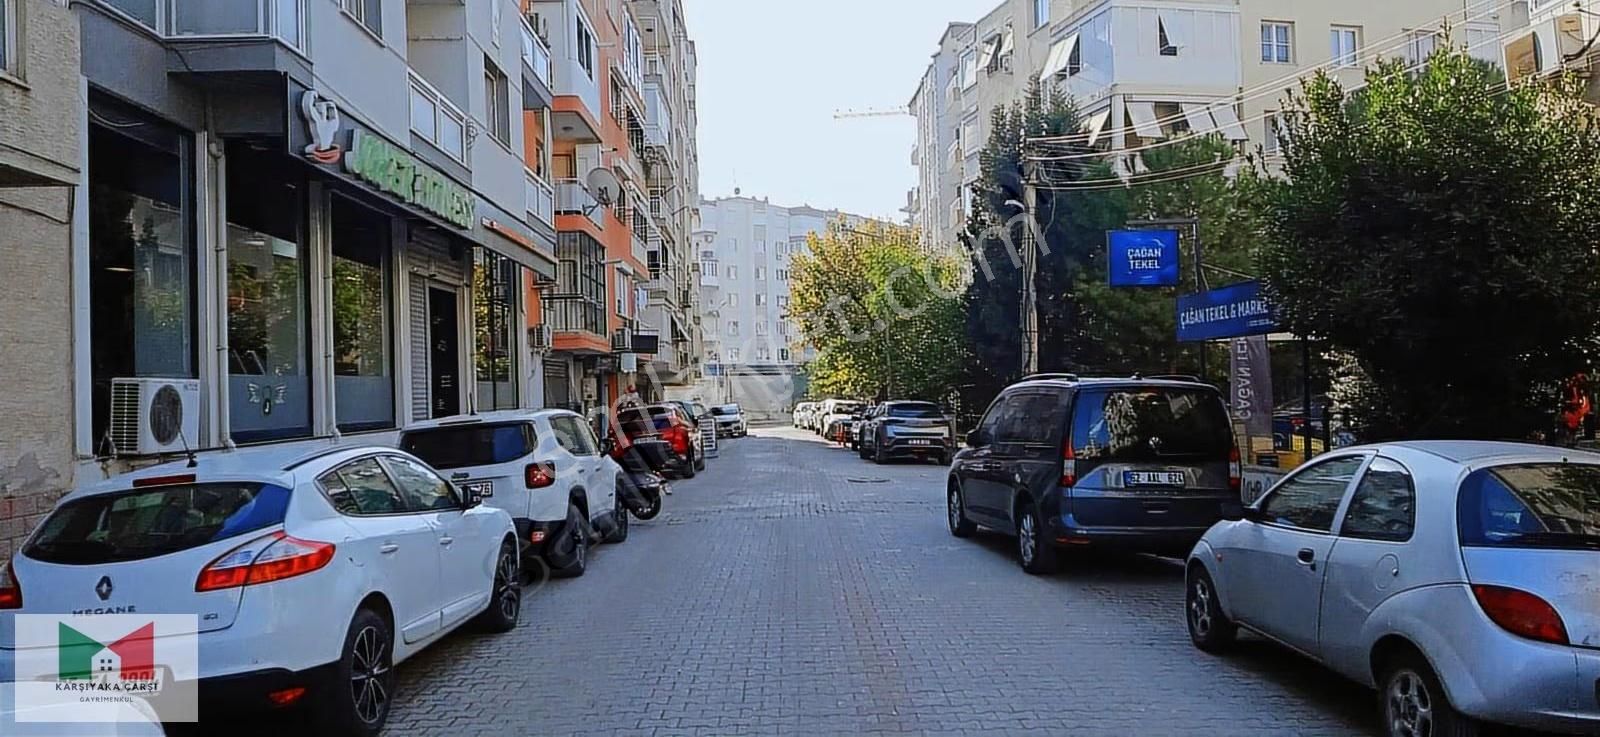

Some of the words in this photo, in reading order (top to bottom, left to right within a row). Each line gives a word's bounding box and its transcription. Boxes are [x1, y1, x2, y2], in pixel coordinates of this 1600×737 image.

[1128, 260, 1161, 270] TEKEL
[1237, 299, 1269, 318] MARKE
[72, 605, 136, 617] MEGANE
